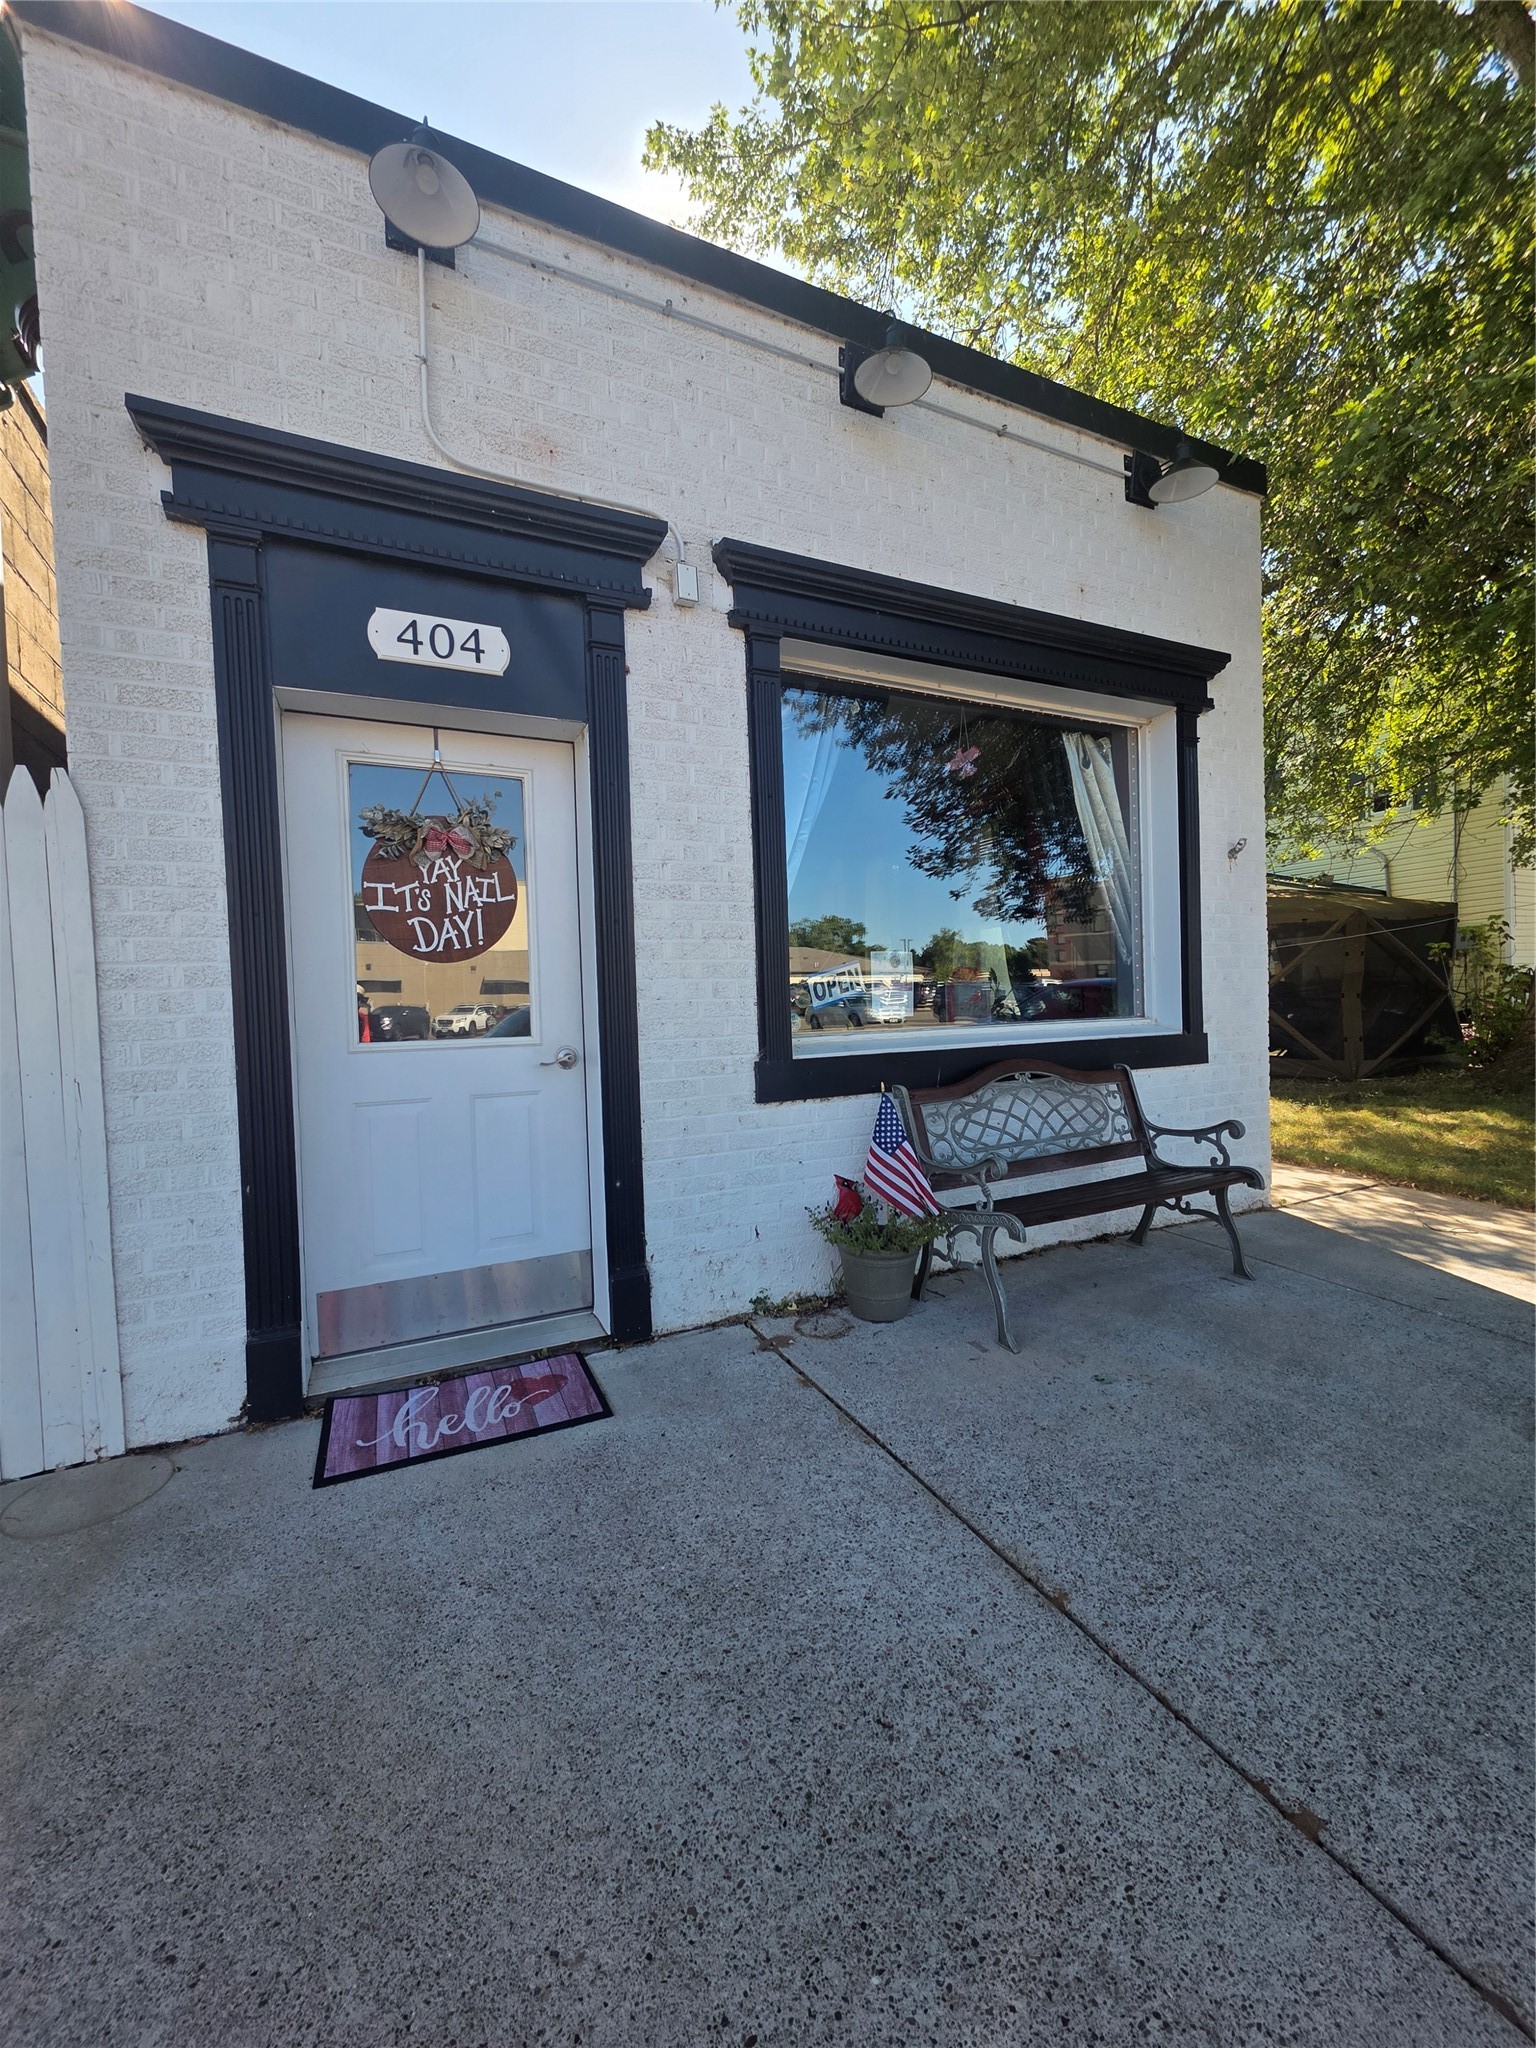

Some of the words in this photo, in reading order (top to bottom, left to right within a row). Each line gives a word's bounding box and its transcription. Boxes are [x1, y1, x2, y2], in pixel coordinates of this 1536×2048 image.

[396, 619, 486, 664] 404
[418, 855, 463, 885] YAY
[444, 871, 516, 915] NAIL
[406, 908, 485, 953] DAY!
[812, 967, 862, 1002] OPEN
[356, 1385, 550, 1450] hello
